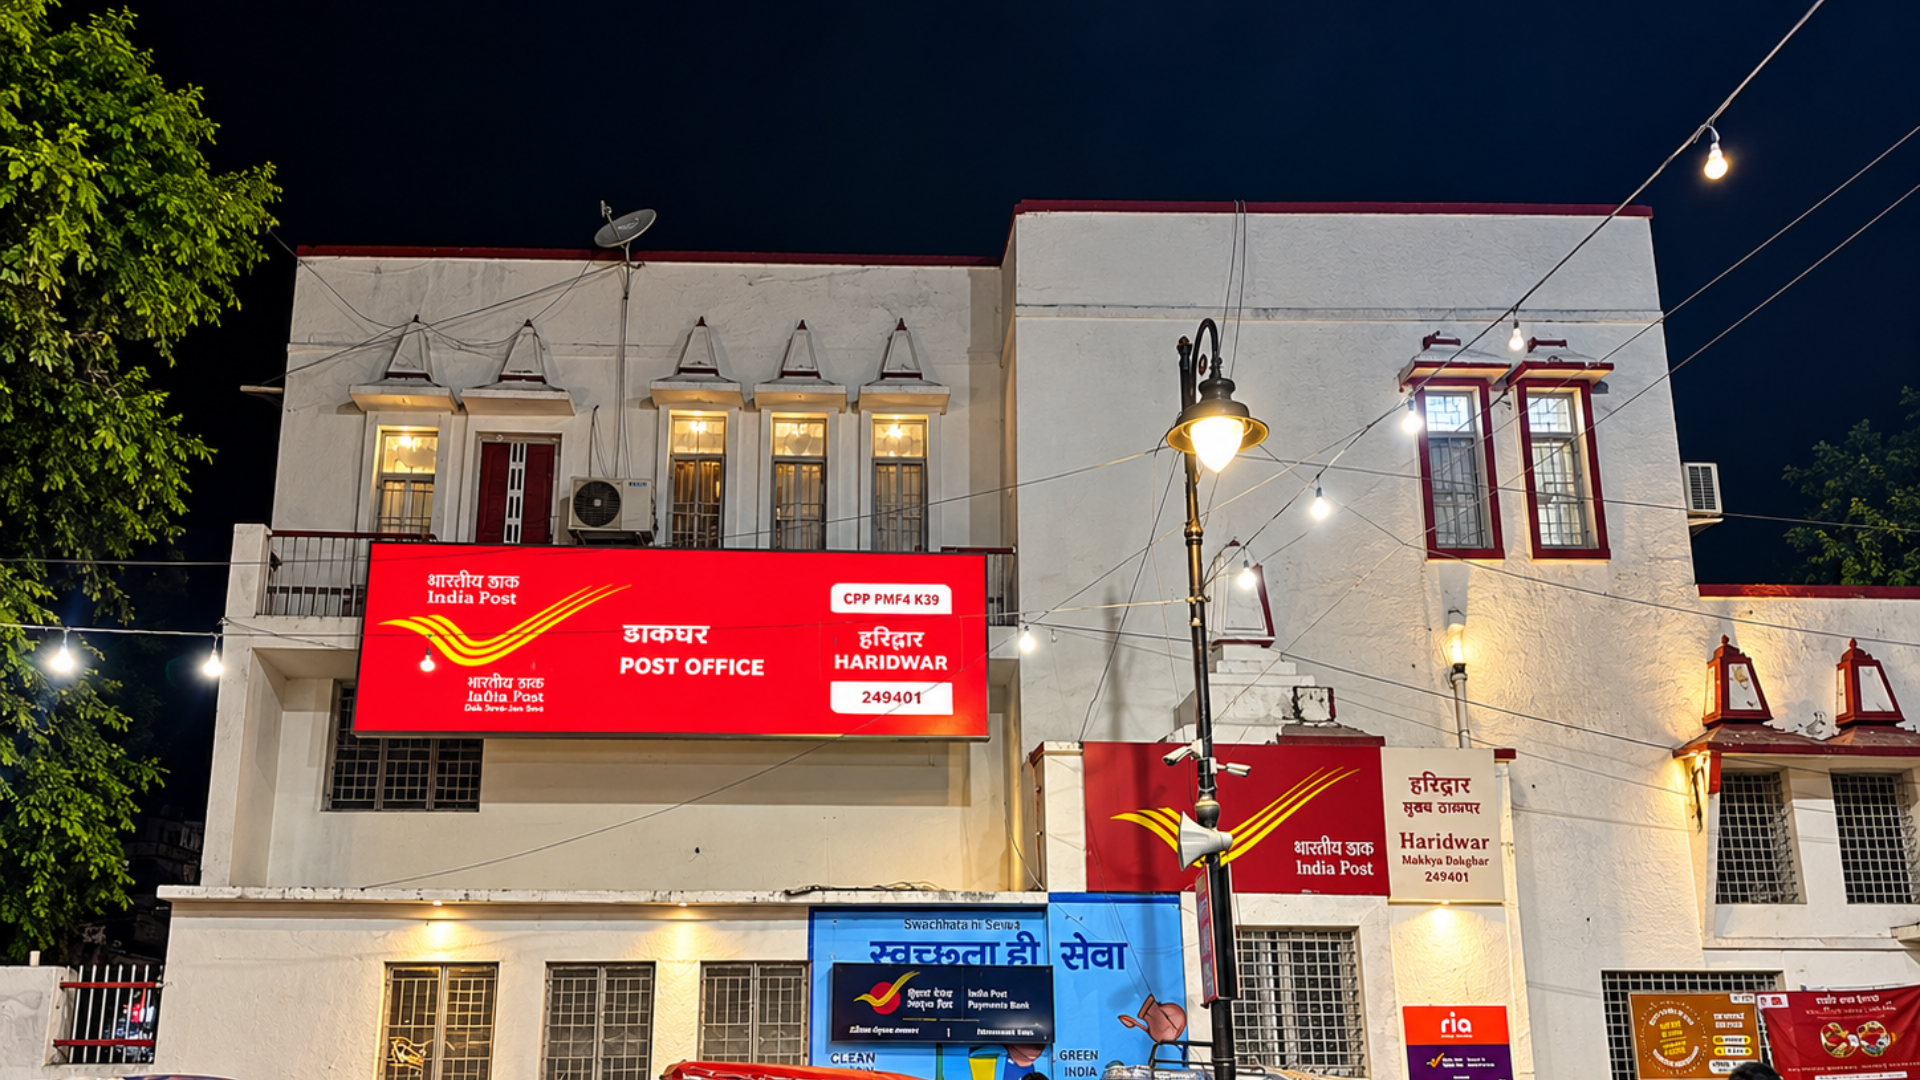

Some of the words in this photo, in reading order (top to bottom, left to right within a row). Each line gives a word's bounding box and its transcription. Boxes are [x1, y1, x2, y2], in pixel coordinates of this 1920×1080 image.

[427, 569, 484, 588] भारतीय
[487, 575, 520, 589] डाक
[427, 590, 474, 604] India
[478, 590, 517, 605] Post
[843, 593, 871, 605] CPP
[874, 593, 911, 605] PMF4
[914, 594, 940, 606] K39
[622, 624, 711, 644] डाकघर
[857, 625, 925, 651] हरिद्वार
[619, 656, 679, 675] POST
[684, 657, 765, 676] OFFICE
[834, 654, 948, 670] HARIDWAR
[861, 690, 921, 704] 249401
[1399, 832, 1490, 850] Haridwar
[1296, 860, 1336, 876] India
[1339, 860, 1375, 876] Post
[1424, 870, 1470, 883] 249401
[1060, 932, 1129, 970] सेवा
[1440, 1011, 1472, 1033] ria
[830, 1052, 876, 1065] CLEAN
[1059, 1050, 1099, 1061] GREEN
[1064, 1066, 1098, 1078] INDIA
